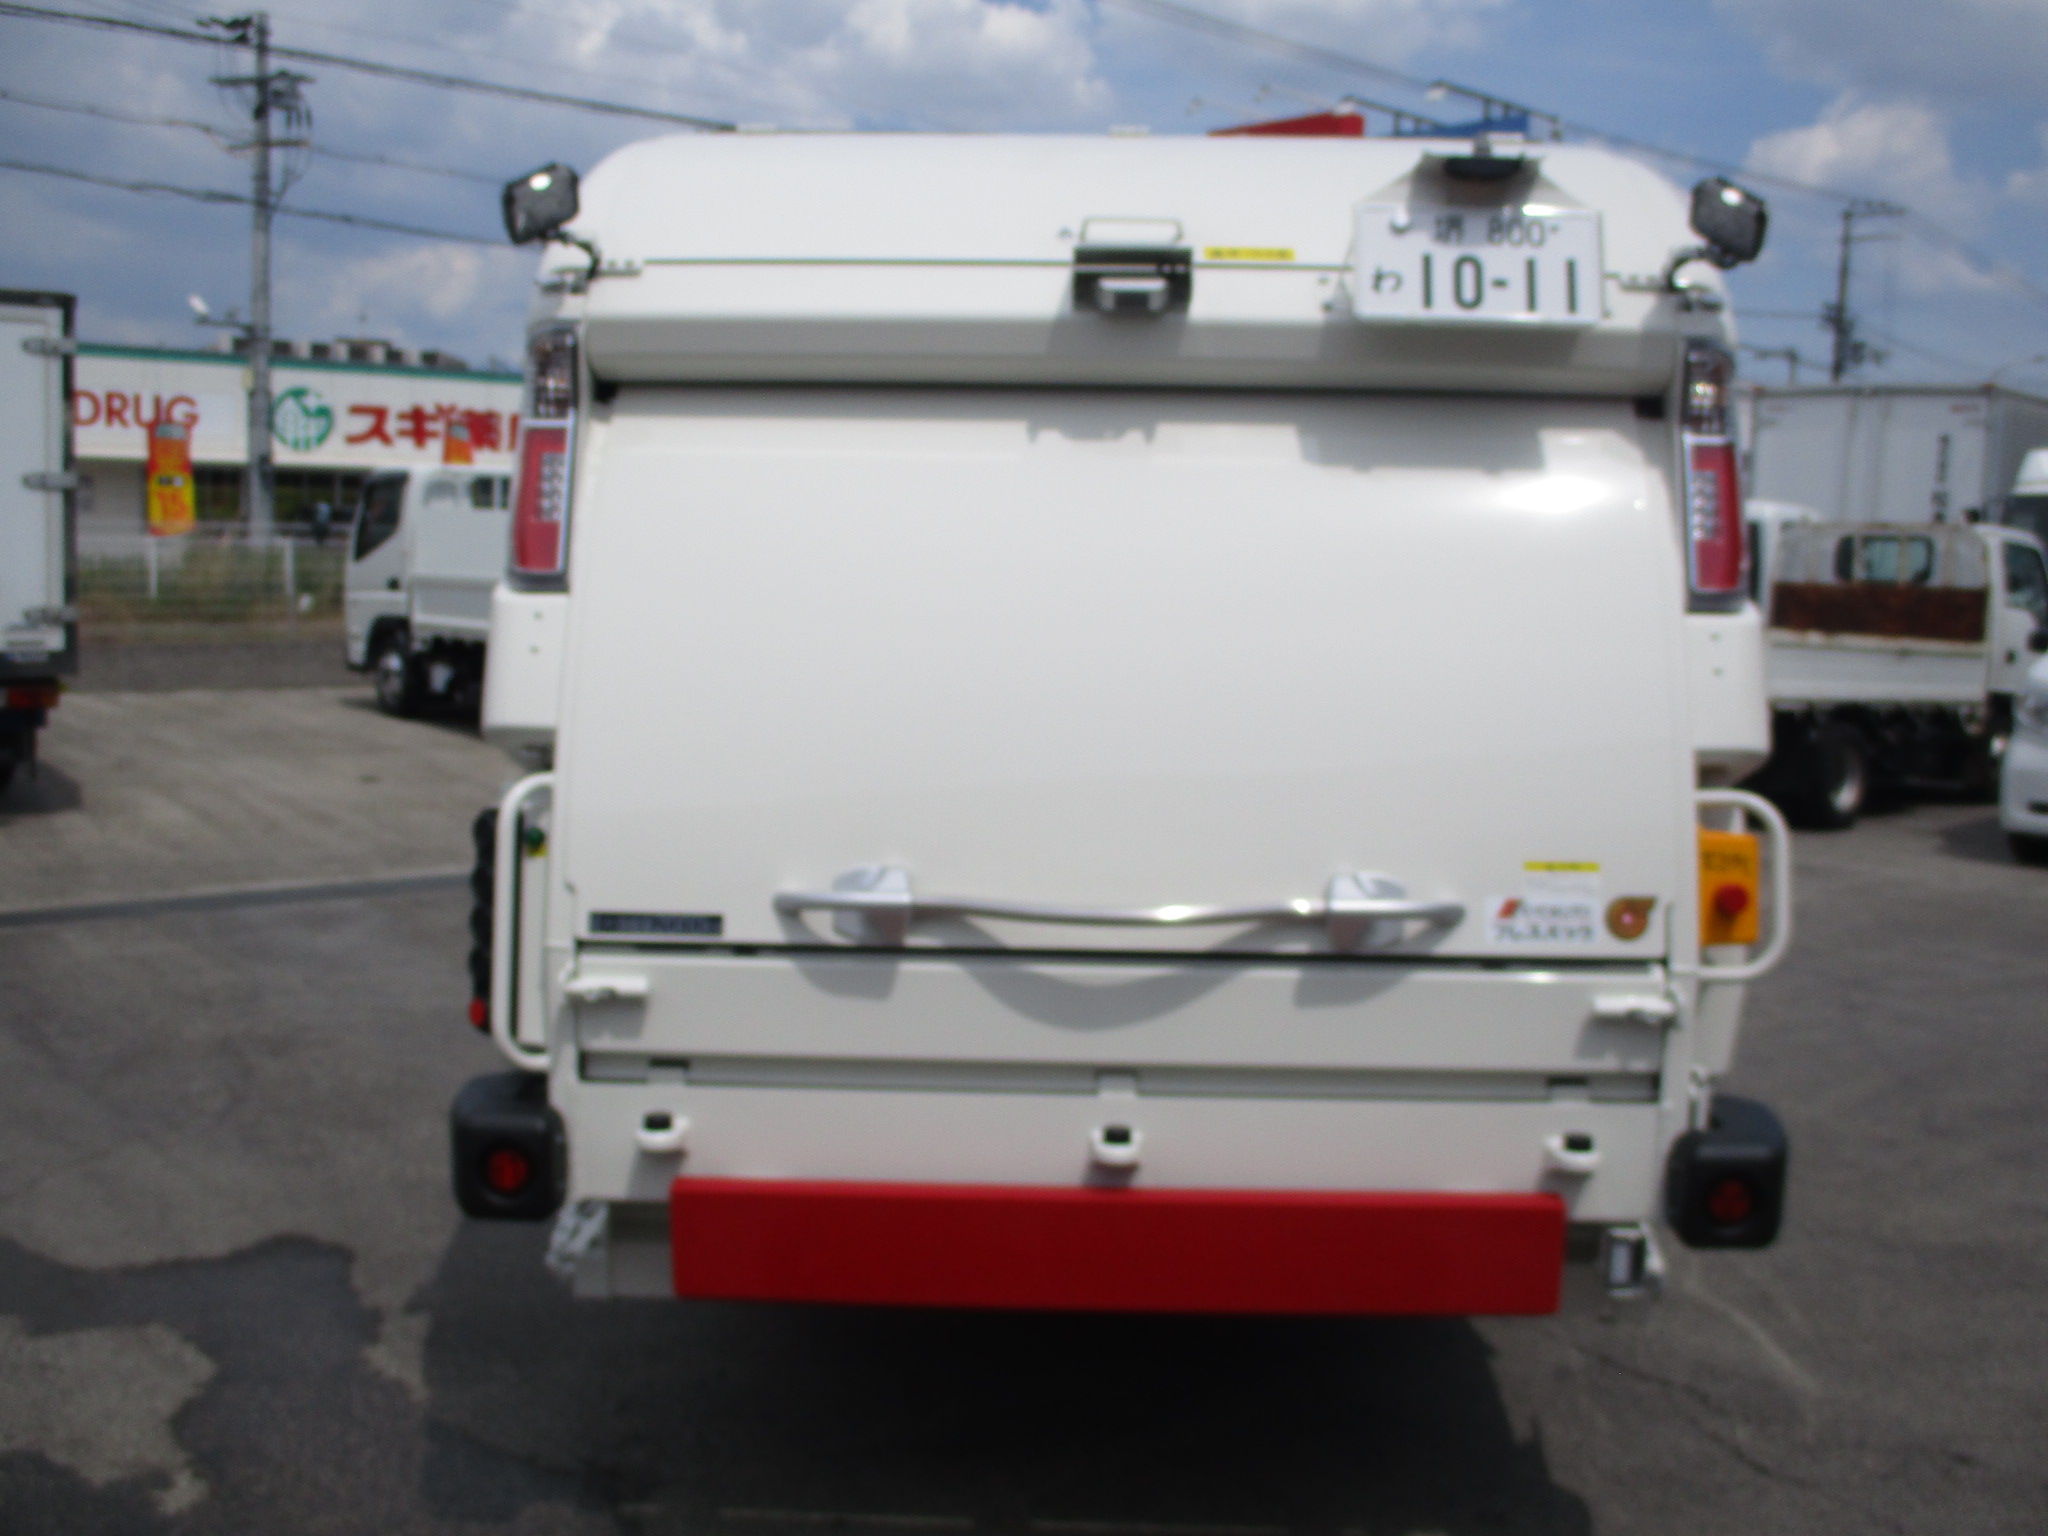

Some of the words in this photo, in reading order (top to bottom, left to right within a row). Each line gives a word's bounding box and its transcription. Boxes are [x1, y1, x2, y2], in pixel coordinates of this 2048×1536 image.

[1487, 214, 1546, 247] 800
[1372, 265, 1403, 293] わ
[1422, 253, 1577, 313] 10-11
[74, 389, 200, 429] DRUG
[345, 402, 520, 451] スギ薬
